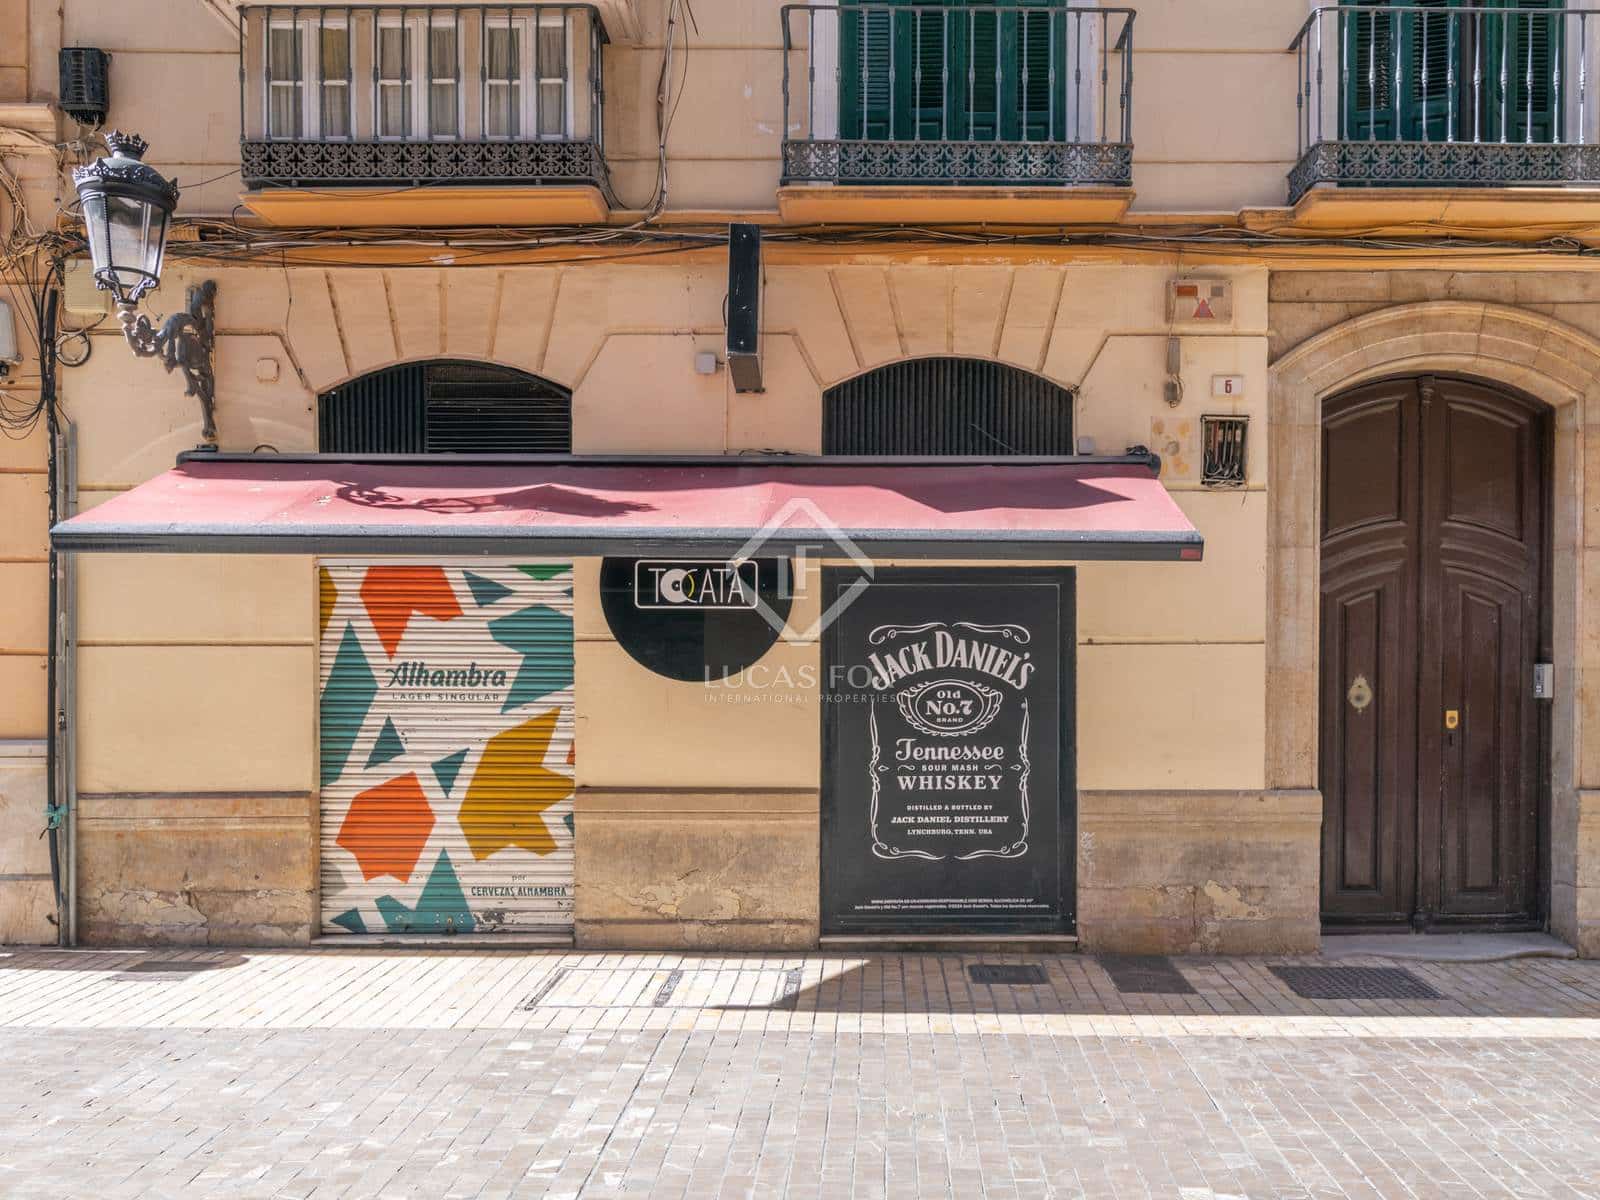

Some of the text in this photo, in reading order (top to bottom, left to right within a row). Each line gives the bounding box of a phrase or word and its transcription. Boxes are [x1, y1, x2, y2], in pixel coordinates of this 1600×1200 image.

[1224, 379, 1233, 394] 6
[383, 661, 507, 688] Alhambra
[391, 691, 500, 701] LAGER SINGULAR
[936, 689, 962, 699] Old
[895, 738, 1005, 761] Tennessee
[921, 764, 979, 772] SOUR MASH
[897, 775, 1003, 791] WHISKEY
[890, 815, 1009, 824] JACK DANIEL DISTILLERY
[470, 886, 568, 897] CERVEZAS ALHAMBRA
